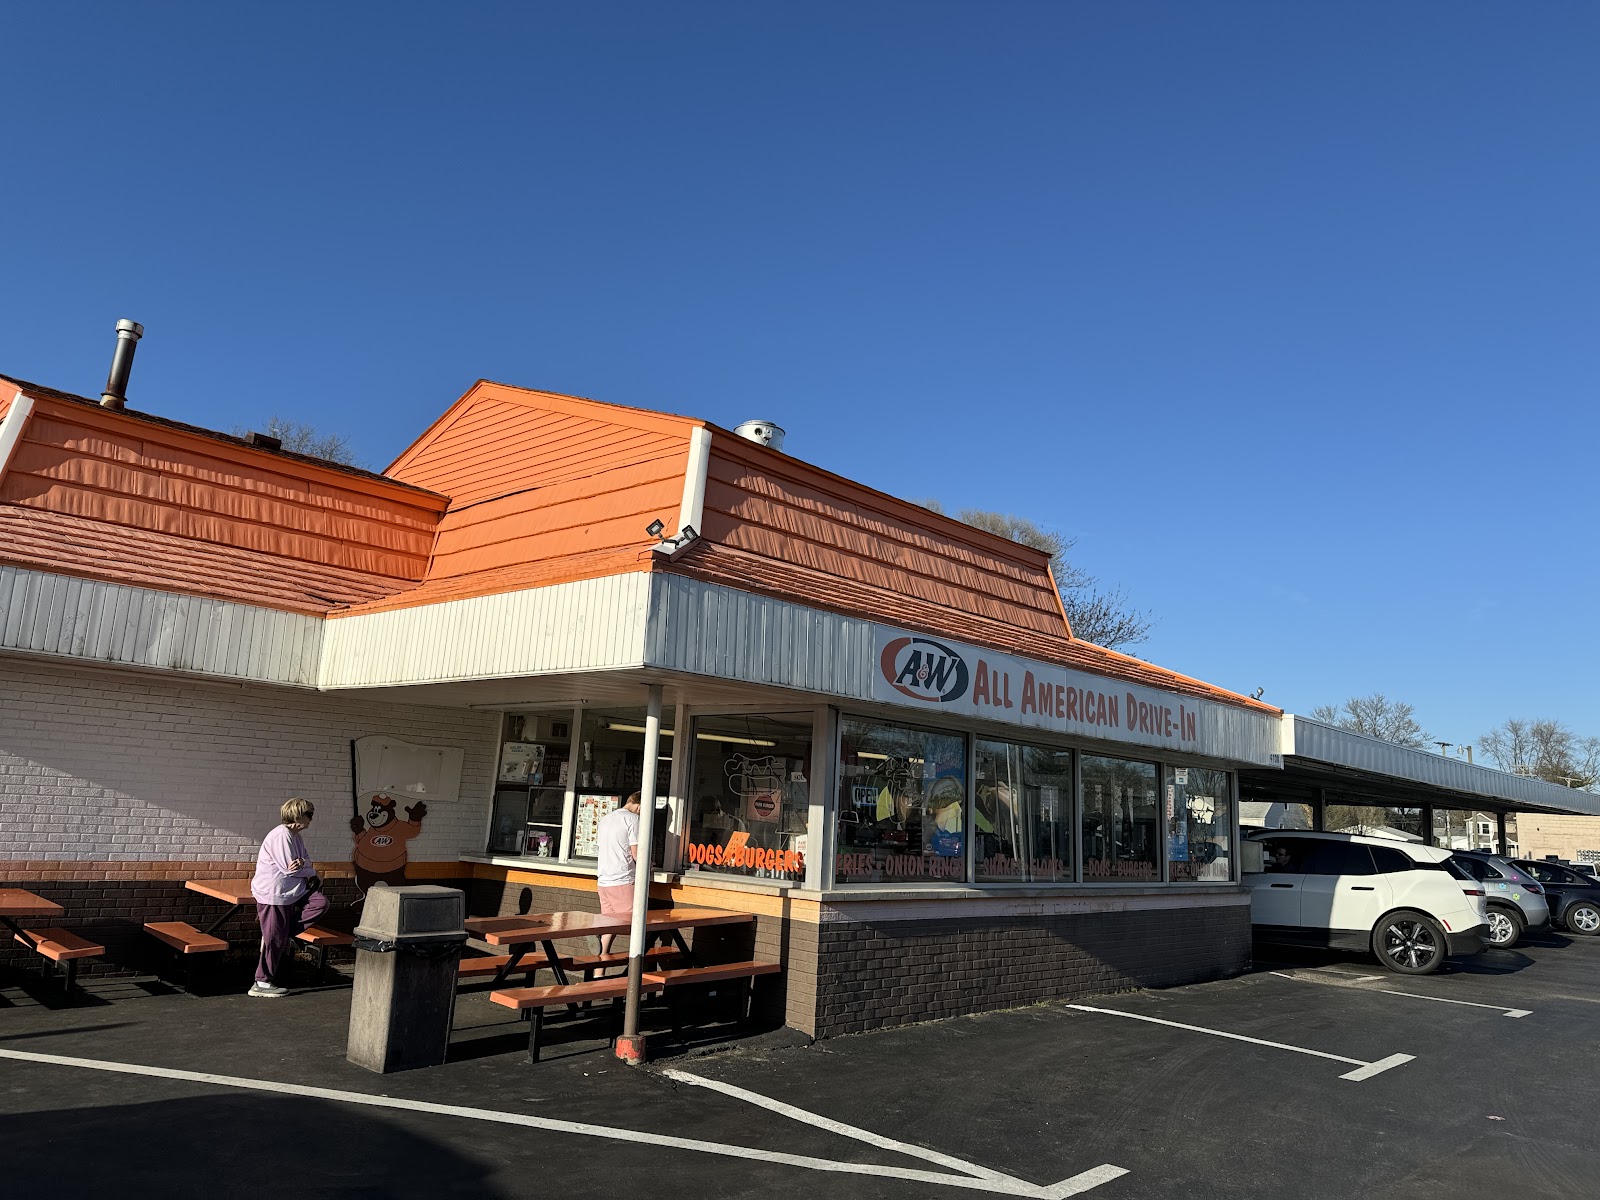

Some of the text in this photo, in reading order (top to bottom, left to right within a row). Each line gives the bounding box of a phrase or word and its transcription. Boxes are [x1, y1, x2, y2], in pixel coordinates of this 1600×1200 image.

[893, 649, 960, 693] A&W
[972, 658, 1197, 742] ALL AMERICAN DRIVE-IN
[854, 787, 878, 804] OPEN
[689, 842, 723, 866] DOGS
[734, 845, 804, 873] BURGERS
[836, 853, 963, 878] FRIES ONION RINGS
